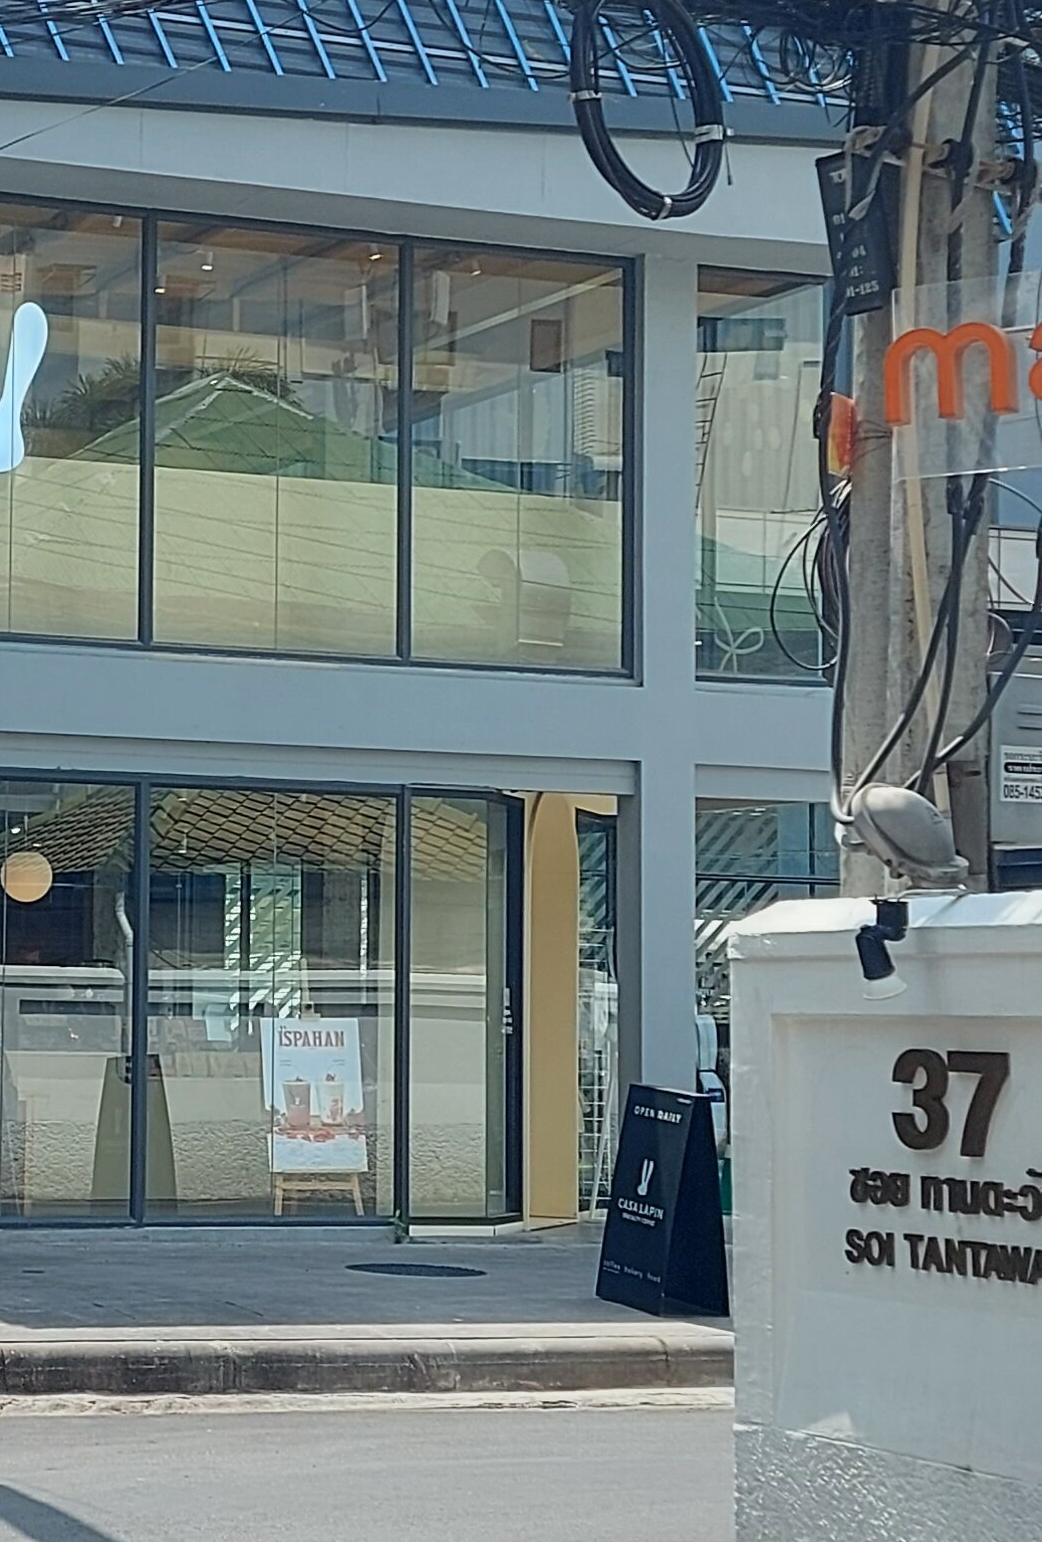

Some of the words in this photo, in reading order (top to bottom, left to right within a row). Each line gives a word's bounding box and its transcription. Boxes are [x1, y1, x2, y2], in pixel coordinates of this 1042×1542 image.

[884, 322, 1042, 426] m
[633, 1105, 655, 1118] OPEN
[657, 1110, 683, 1124] DAILY
[891, 1048, 1011, 1157] 37
[618, 1197, 638, 1213] CASA
[849, 1167, 911, 1207] ซอย
[845, 1228, 896, 1267] SOI
